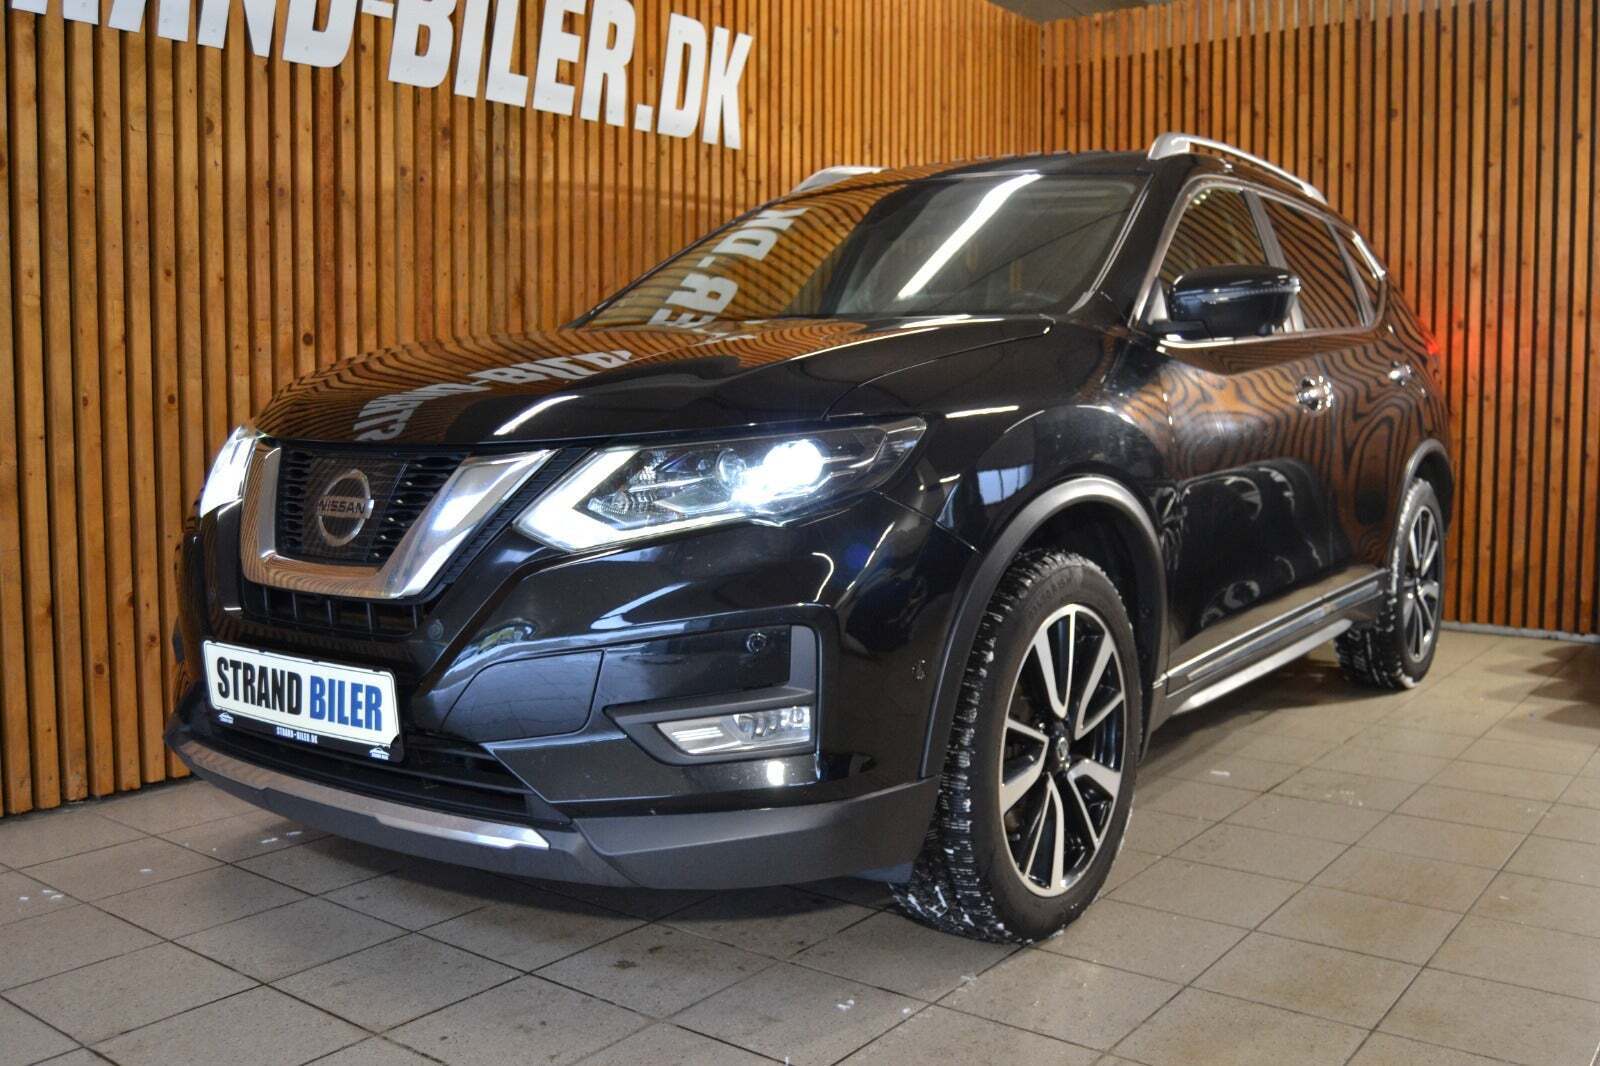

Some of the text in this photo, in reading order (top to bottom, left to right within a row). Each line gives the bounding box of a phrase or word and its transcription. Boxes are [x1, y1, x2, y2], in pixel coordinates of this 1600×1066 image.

[319, 498, 365, 515] NISSAN
[217, 656, 383, 732] STRAND BILER
